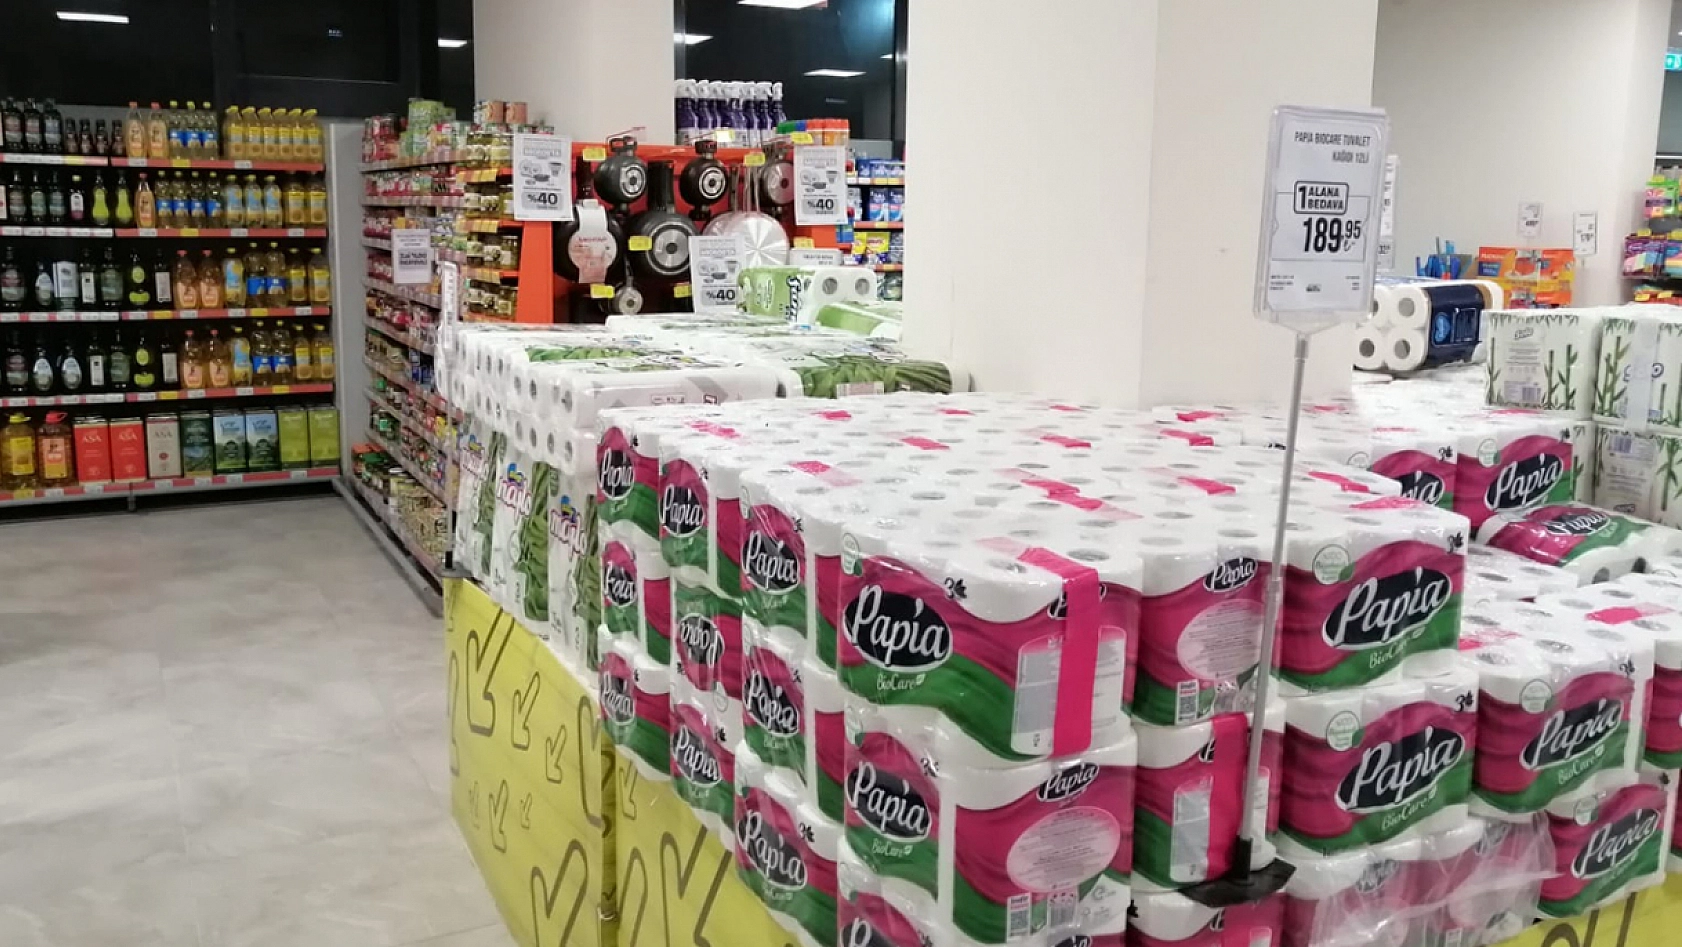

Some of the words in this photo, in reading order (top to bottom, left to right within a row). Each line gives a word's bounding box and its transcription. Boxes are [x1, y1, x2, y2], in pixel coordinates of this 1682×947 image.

[1344, 134, 1371, 147] TUVALET
[1298, 186, 1306, 209] 1
[1308, 187, 1339, 197] ALANA
[1308, 199, 1343, 209] BEDAVA
[601, 447, 632, 497] Papia
[1492, 453, 1558, 512] Papia
[663, 485, 702, 535] Papia
[745, 530, 797, 588] Papia
[1210, 556, 1255, 591] Papia
[853, 585, 947, 666] Papia
[1333, 567, 1447, 647] Papia
[749, 671, 797, 733] Papia
[876, 673, 916, 690] BioCare
[677, 725, 720, 778] Papia
[1532, 698, 1618, 768] Papia
[1043, 761, 1096, 800] Papia
[1347, 726, 1457, 808] Papia
[854, 761, 927, 835] Papia
[1381, 801, 1426, 831] BioCare
[745, 810, 804, 884] Papia
[1580, 809, 1656, 877] Papia
